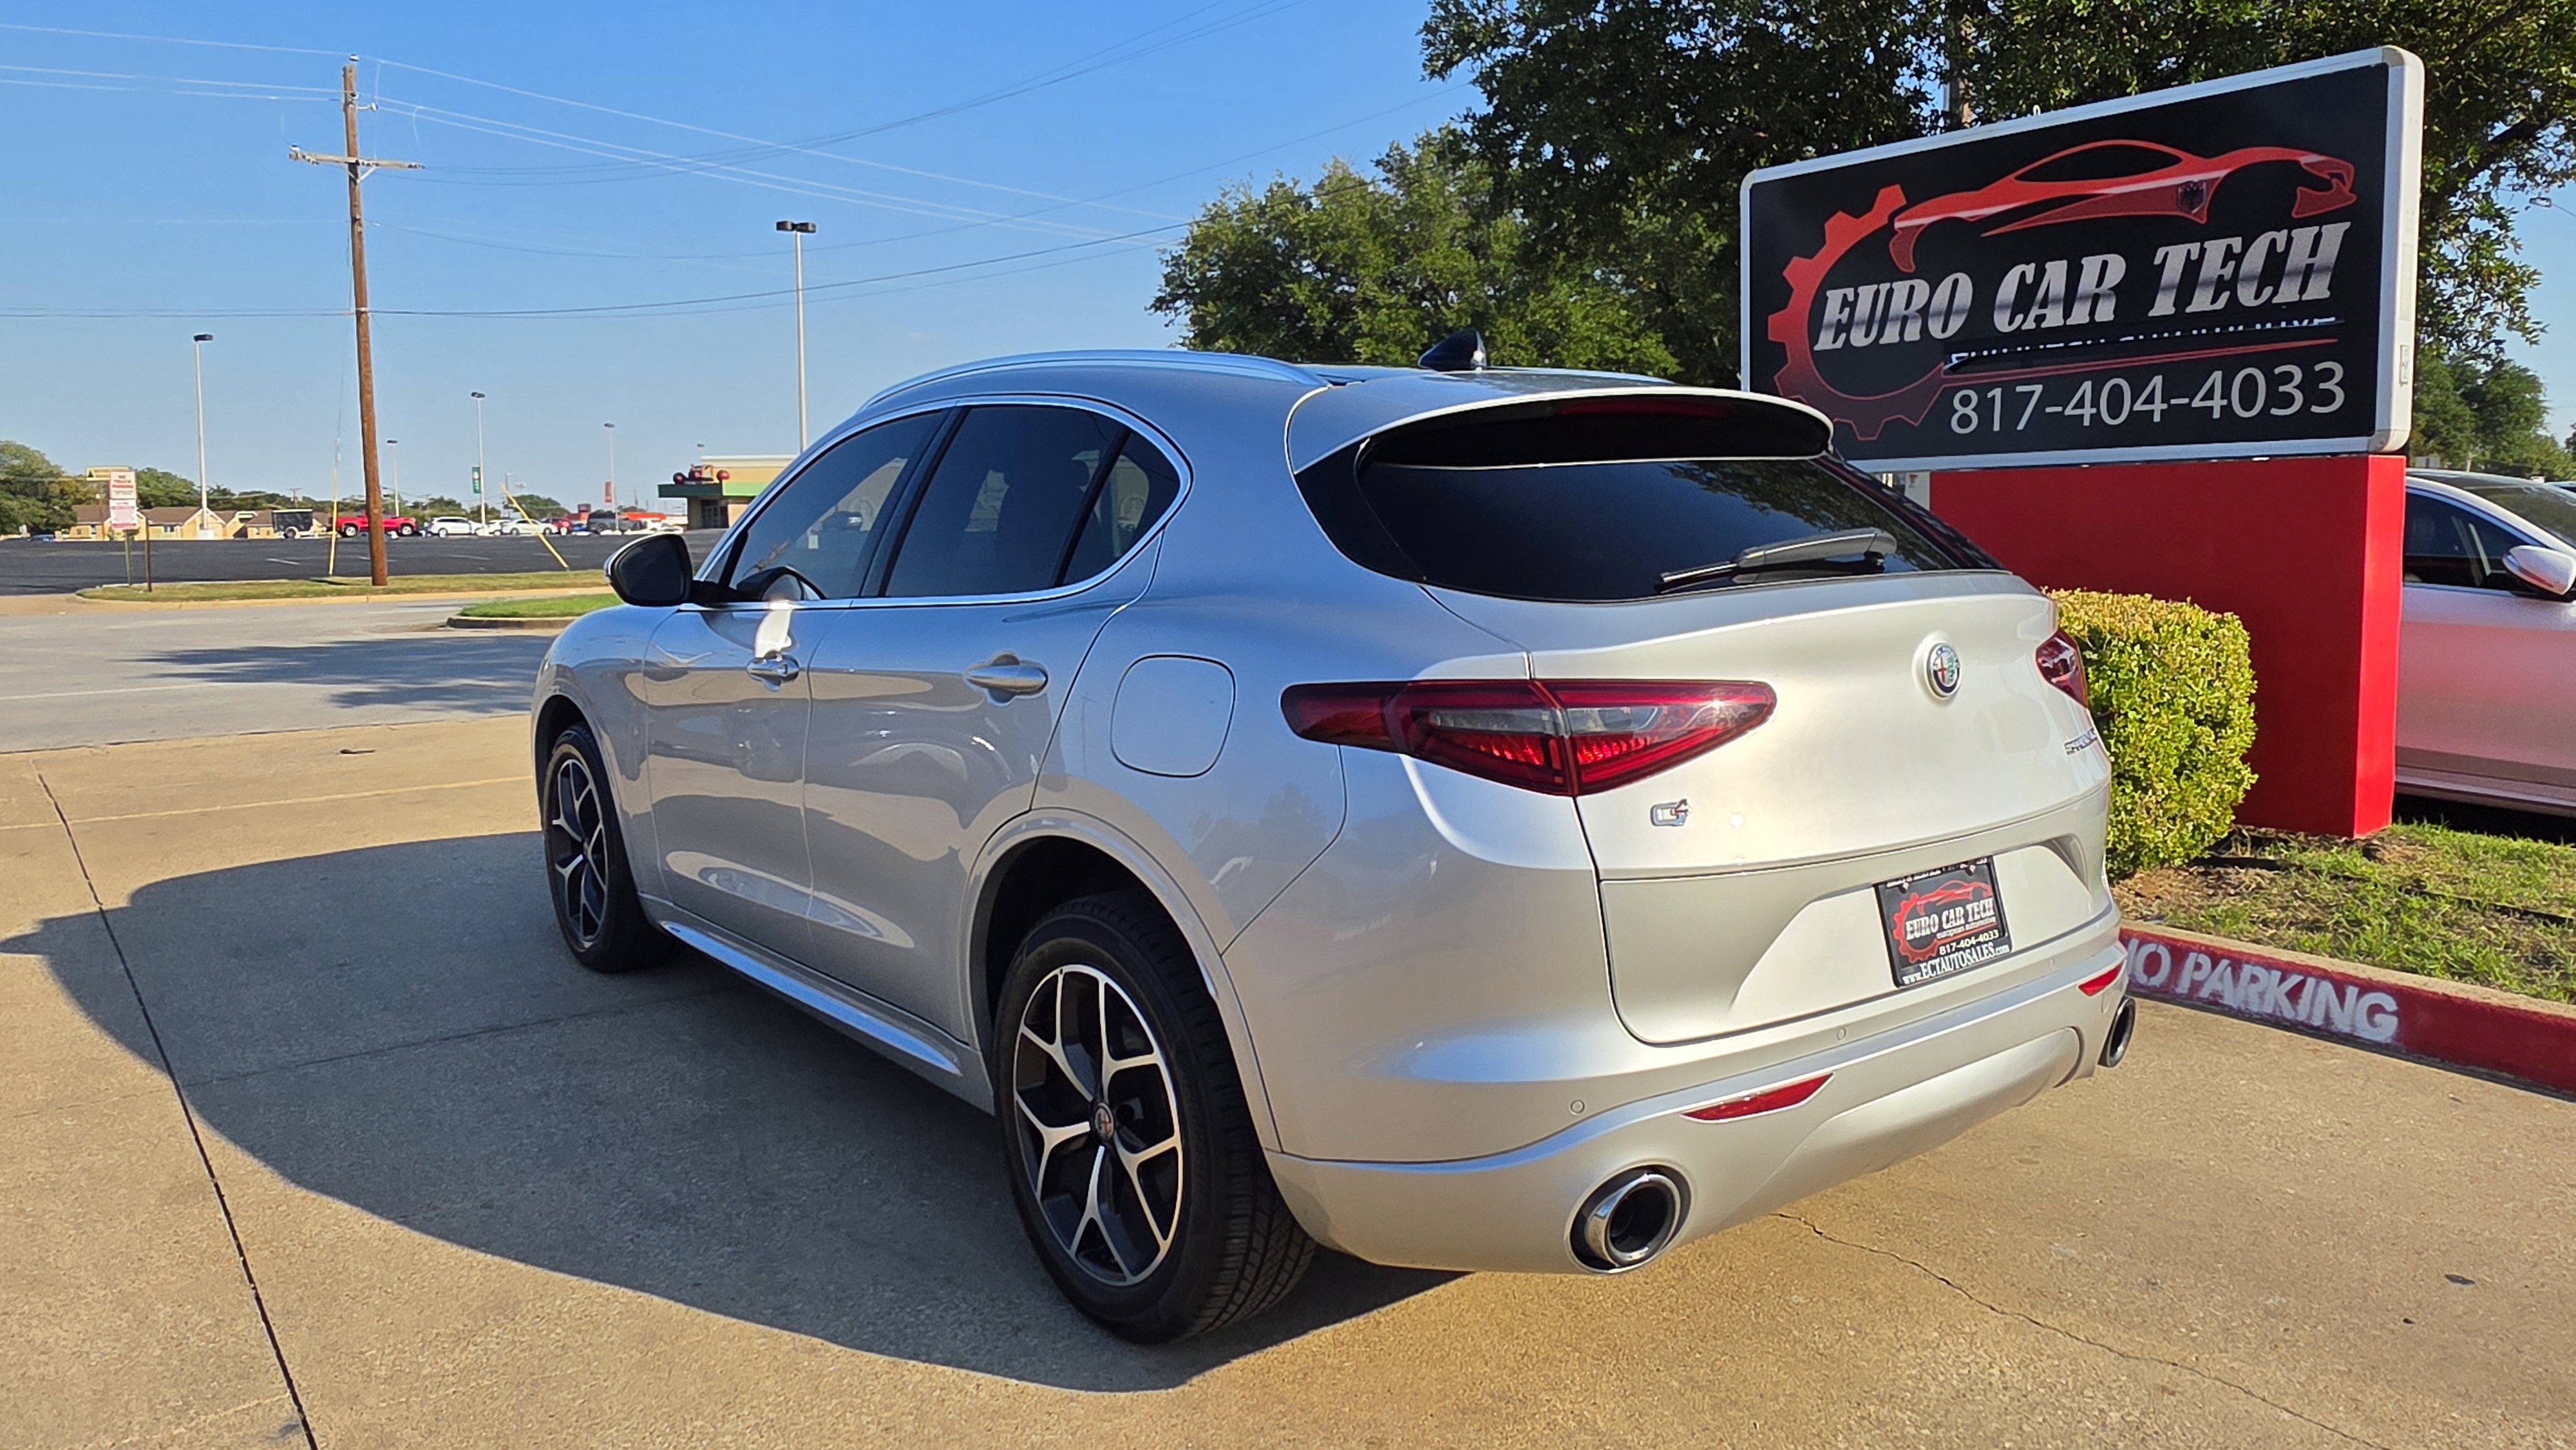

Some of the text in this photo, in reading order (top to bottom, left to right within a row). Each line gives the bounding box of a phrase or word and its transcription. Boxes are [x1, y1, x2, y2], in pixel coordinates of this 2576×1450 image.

[1814, 272, 1973, 350] EURO
[1994, 254, 2126, 333] CAR
[2148, 221, 2352, 317] TECH
[1950, 361, 2345, 435] 817-404-4033
[1905, 914, 1939, 941] EURO
[1941, 907, 1965, 929] CAR
[1965, 898, 1995, 923] TECH
[1938, 929, 2000, 956] 817-404-4033
[2174, 952, 2399, 1044] PARKING
